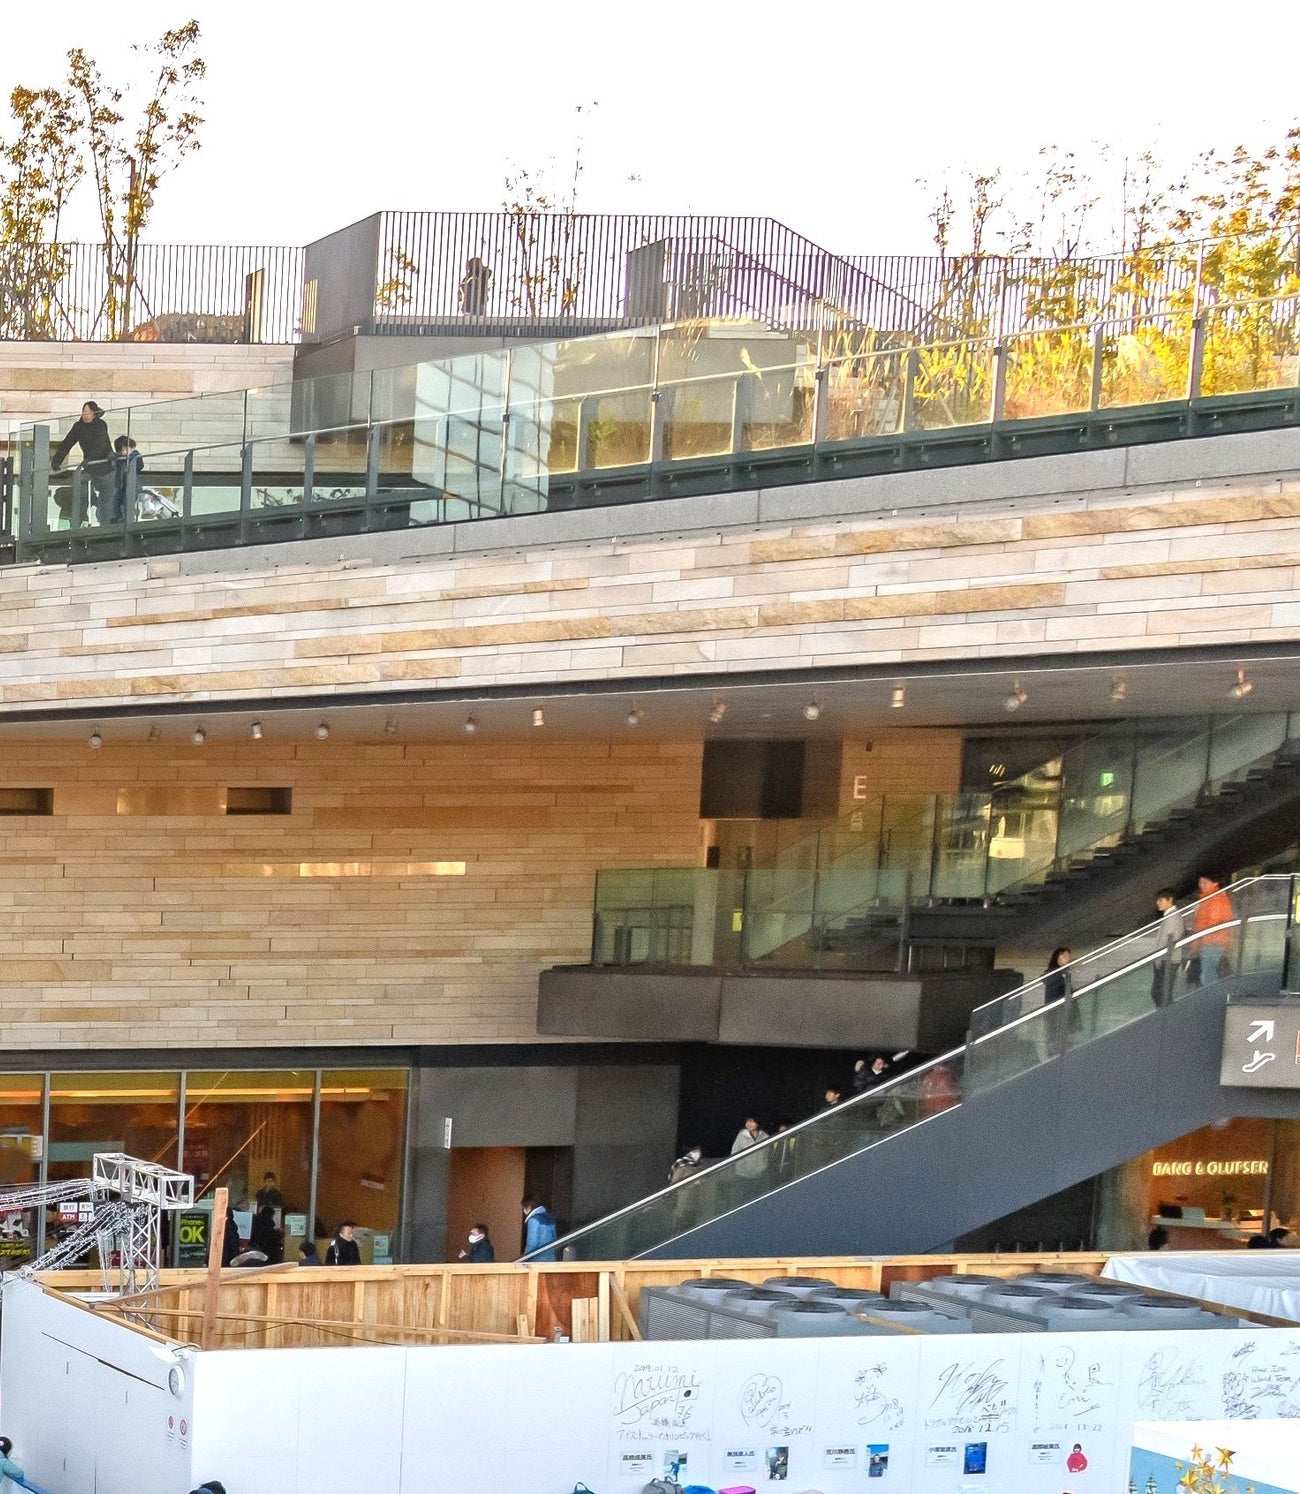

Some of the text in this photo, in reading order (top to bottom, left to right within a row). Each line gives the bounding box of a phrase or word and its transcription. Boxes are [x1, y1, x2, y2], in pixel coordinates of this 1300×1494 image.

[853, 775, 868, 799] E
[1152, 1161, 1192, 1176] BANG
[1195, 1161, 1205, 1175] &
[180, 1226, 205, 1243] OK
